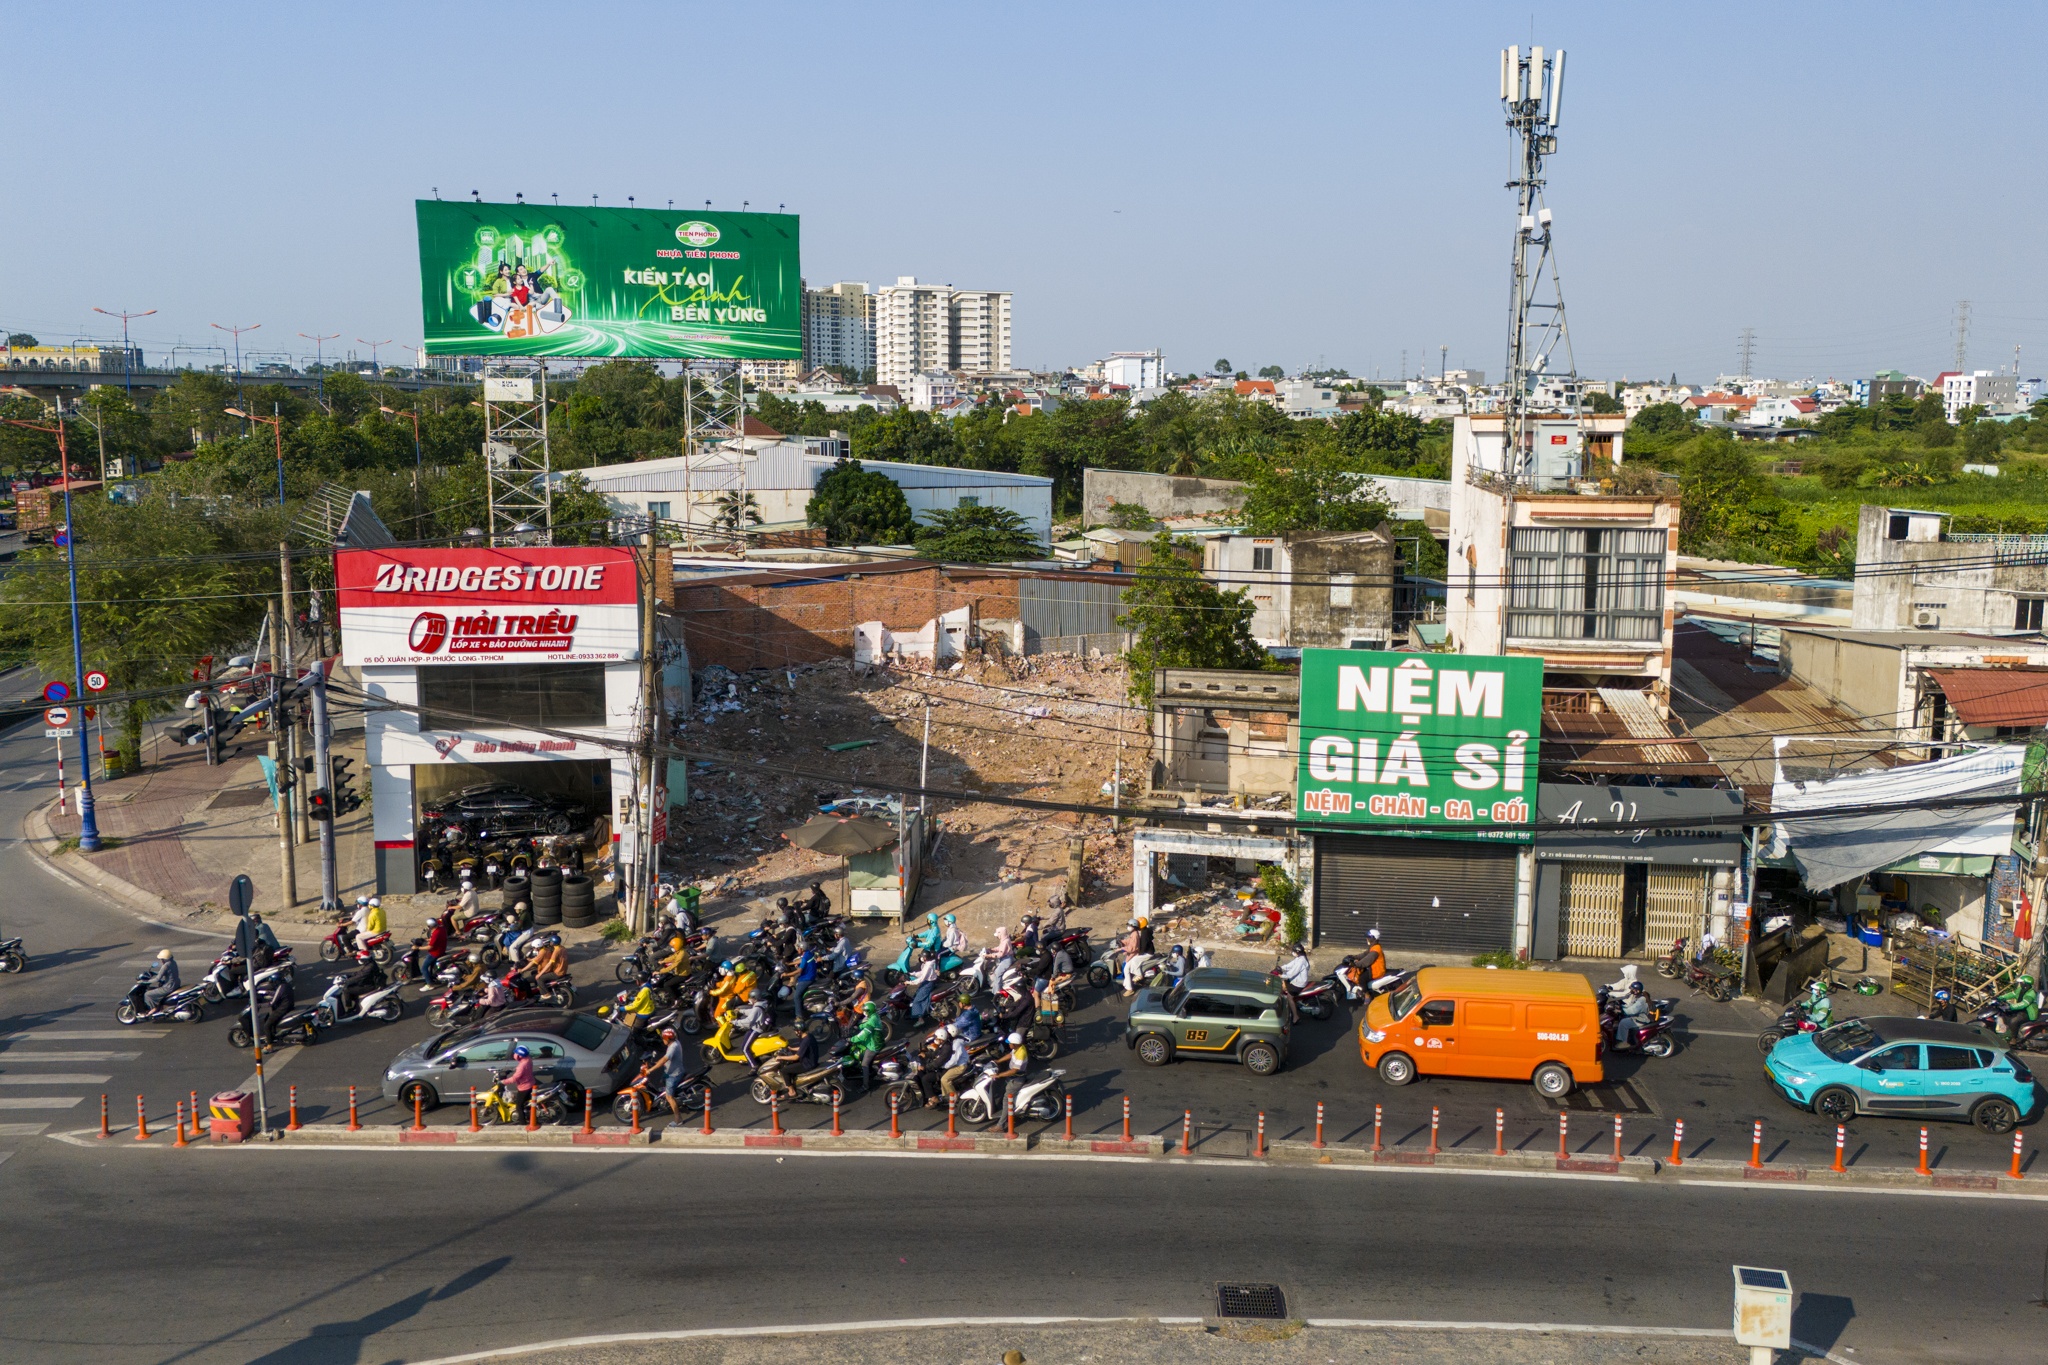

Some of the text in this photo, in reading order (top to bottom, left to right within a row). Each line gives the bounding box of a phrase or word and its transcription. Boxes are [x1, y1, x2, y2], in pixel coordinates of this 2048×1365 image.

[657, 249, 683, 260] NHỰA
[709, 252, 740, 260] PHONG
[623, 266, 710, 289] KIẾN TẠO
[639, 266, 751, 318] Xanh
[671, 302, 767, 323] BỀN VỮNG
[373, 564, 605, 592] BRIDGESTONE
[452, 608, 578, 635] HẢI TRIỀU
[452, 639, 468, 649] LỐP
[469, 641, 481, 649] XE
[488, 638, 507, 649] BẢO
[507, 638, 538, 648] DƯỠNG
[539, 640, 569, 648] NHANH
[374, 654, 385, 663] ĐỖ
[91, 677, 102, 686] 50
[1337, 658, 1505, 725] NỆM
[473, 738, 577, 754] Bảo Dưỡng Nhanh
[1308, 730, 1530, 792] GIÁ SỈ
[1304, 788, 1352, 815] NỆM
[1369, 793, 1427, 818] CHĂN
[1444, 799, 1474, 820] GA
[1492, 797, 1529, 824] GỐI
[1655, 829, 1723, 838] BOUTIQUE
[1186, 1029, 1209, 1042] 89
